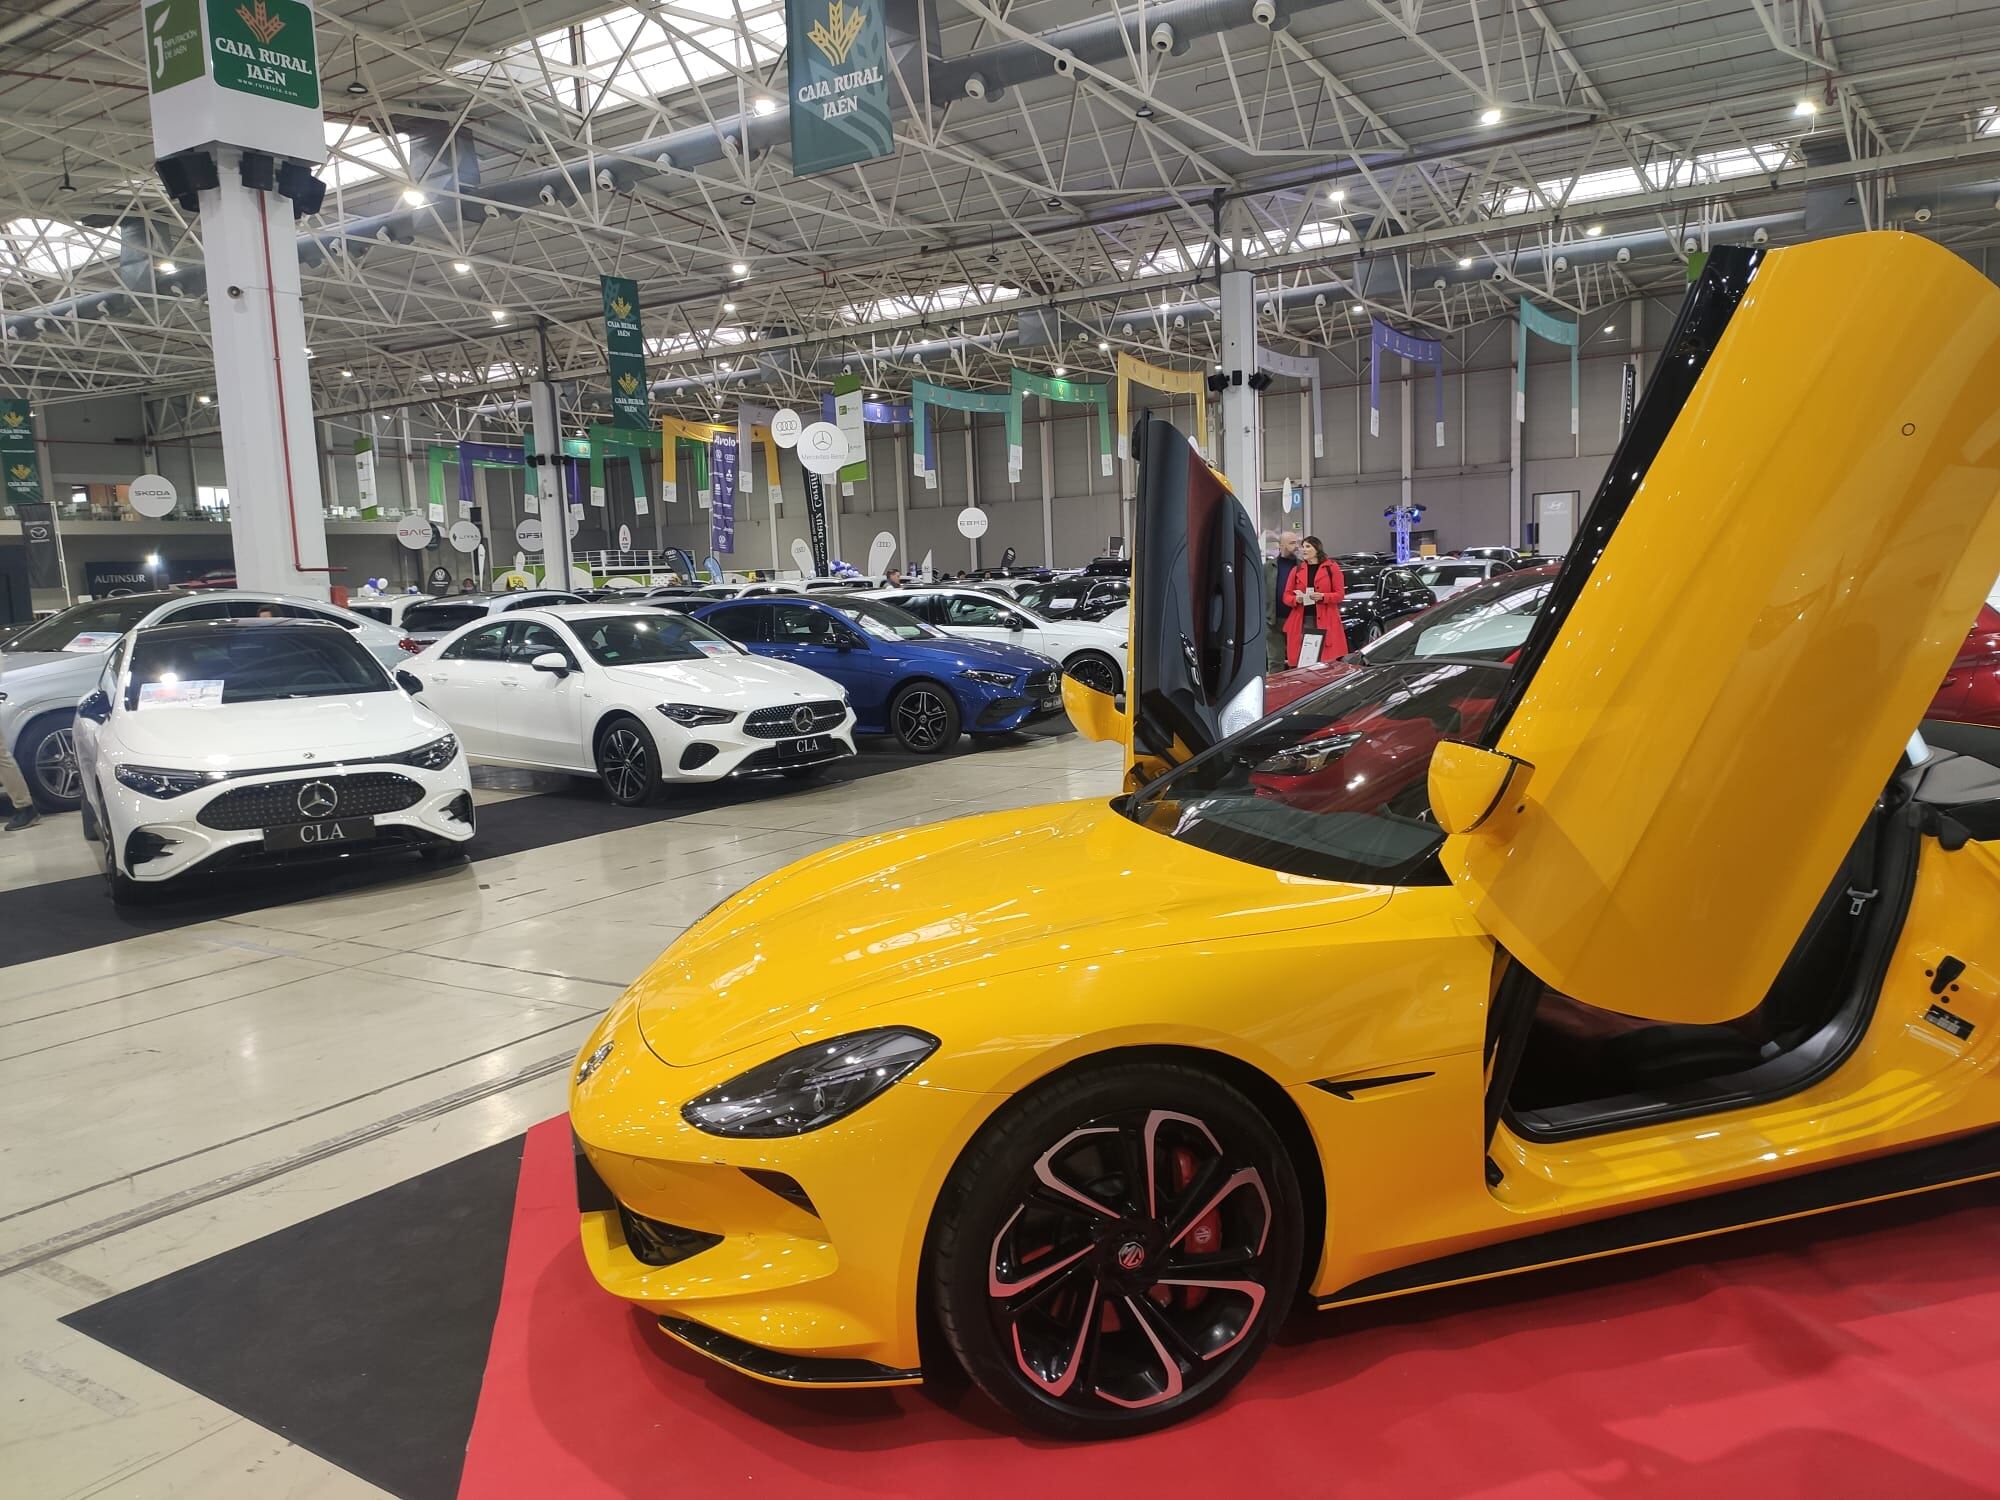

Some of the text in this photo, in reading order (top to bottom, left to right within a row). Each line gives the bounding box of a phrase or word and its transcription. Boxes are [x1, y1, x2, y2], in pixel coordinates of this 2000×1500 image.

[215, 37, 312, 75] CAJA RURAL
[798, 66, 883, 103] CAJA RURAL
[823, 95, 858, 120] JAÉN
[400, 529, 431, 537] BAIC
[95, 573, 146, 584] AUTINSUR
[796, 739, 818, 753] CLA
[300, 820, 347, 844] CLA
